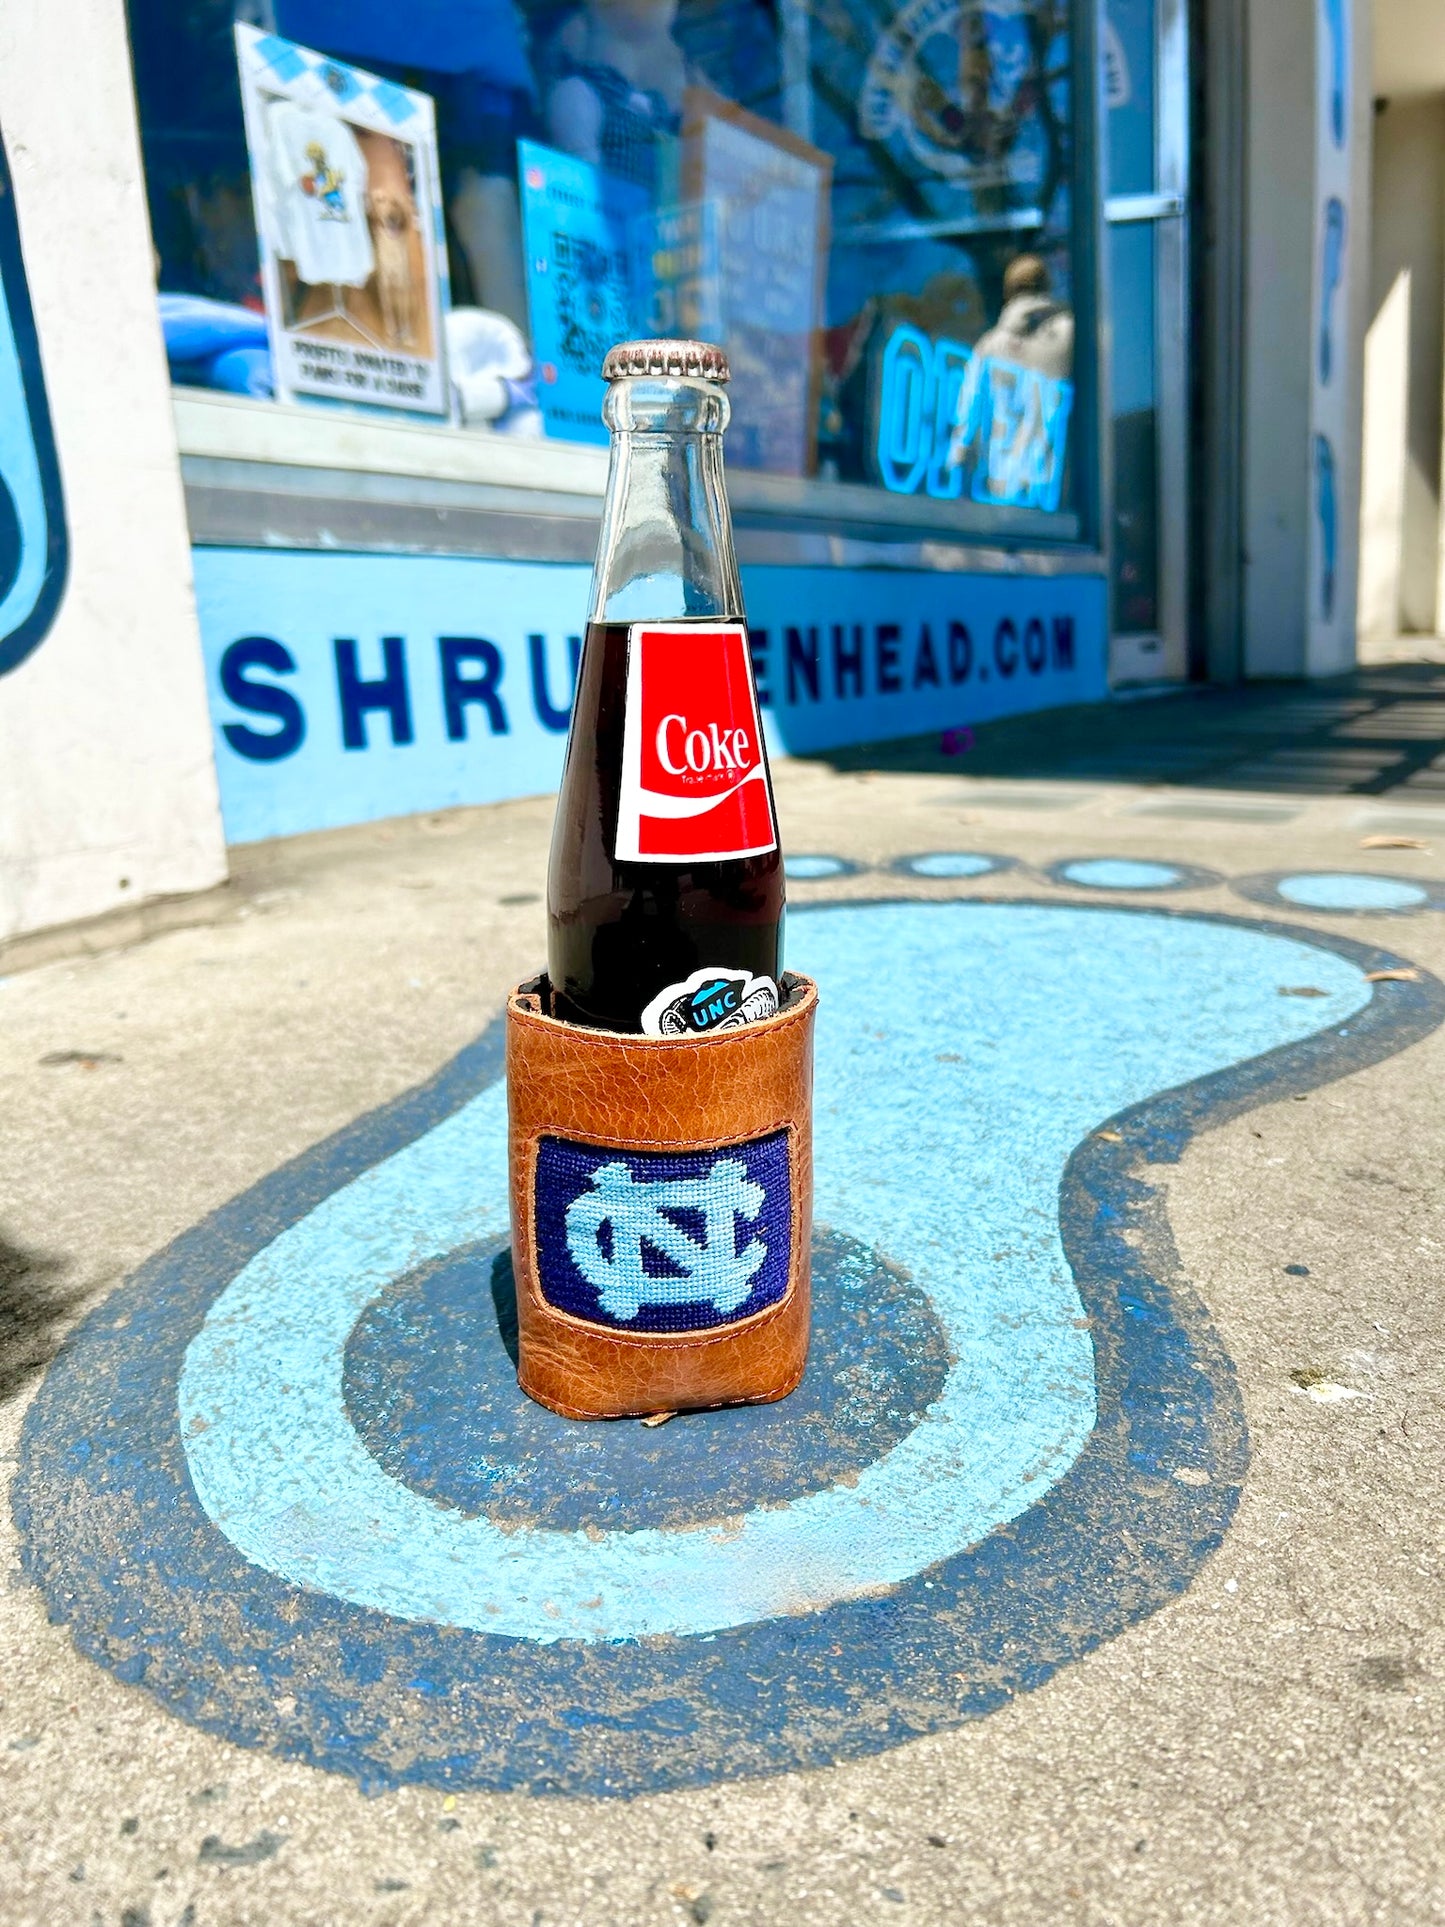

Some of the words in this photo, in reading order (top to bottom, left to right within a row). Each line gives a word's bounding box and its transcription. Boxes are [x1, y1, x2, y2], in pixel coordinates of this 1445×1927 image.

[877, 322, 1075, 512] OPEN
[218, 616, 1076, 763] SHRUENHEAD.COM
[656, 714, 750, 775] Coke
[693, 991, 737, 1026] UNC
